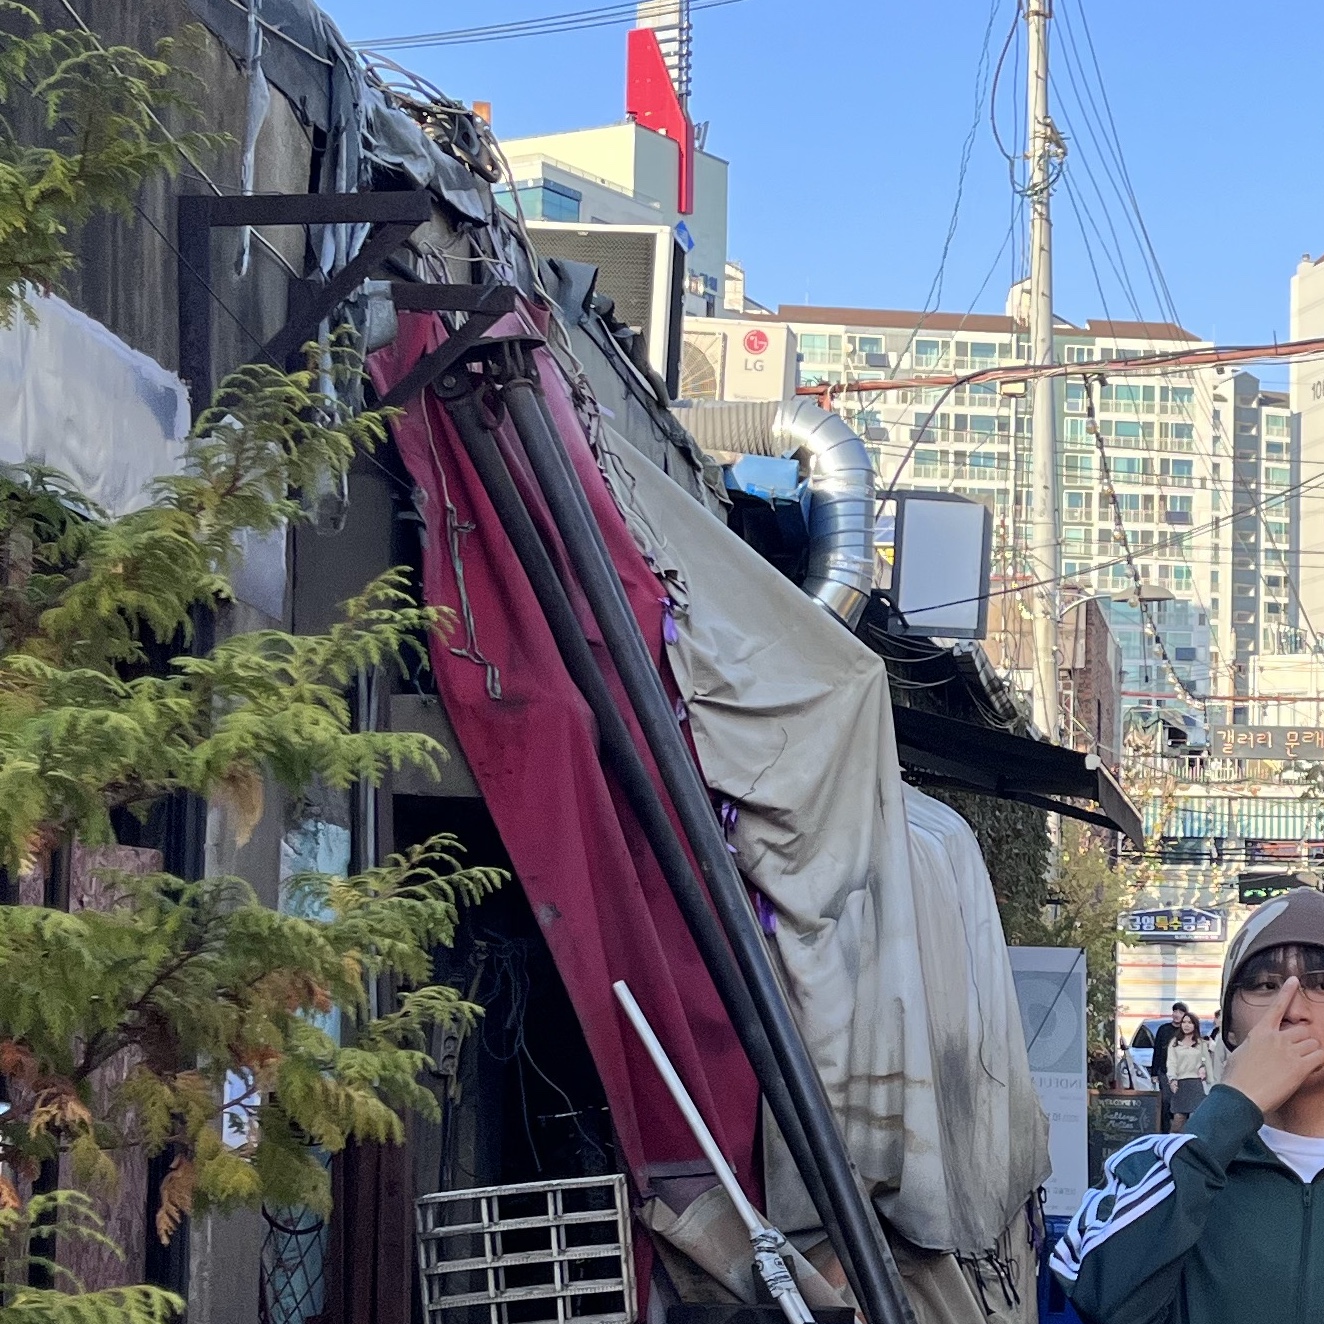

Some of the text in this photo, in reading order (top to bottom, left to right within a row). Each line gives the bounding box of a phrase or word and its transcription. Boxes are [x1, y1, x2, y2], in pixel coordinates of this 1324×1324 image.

[744, 359, 764, 372] LG
[1216, 728, 1324, 758] 갤러리 문래
